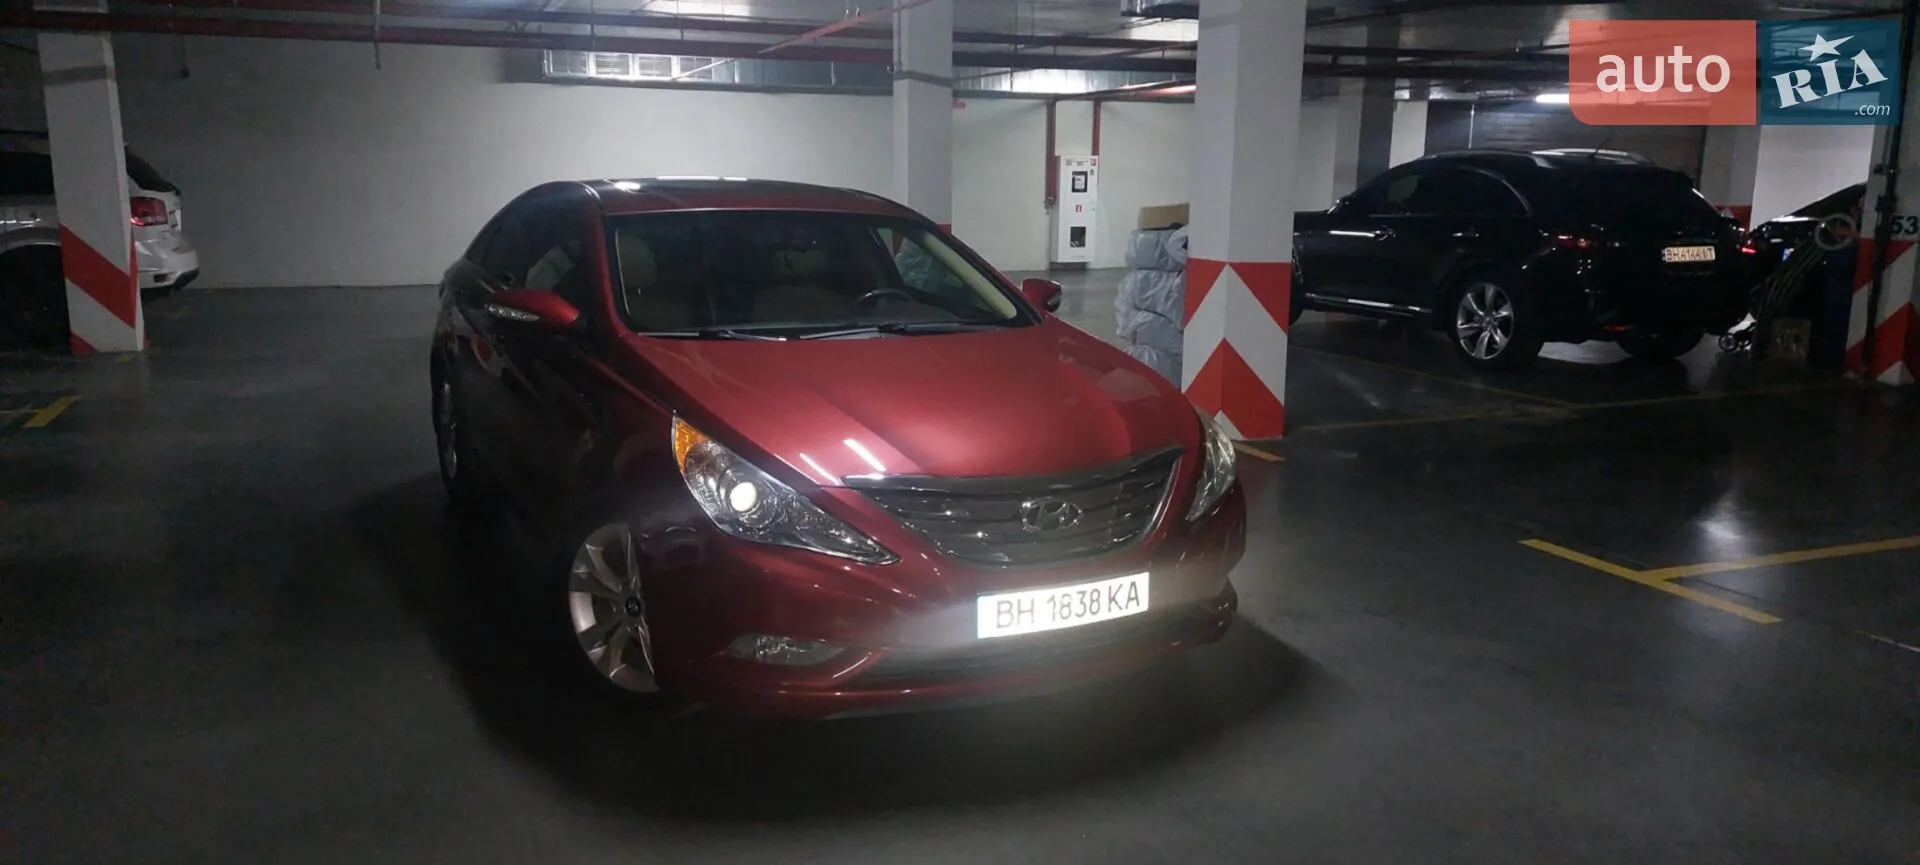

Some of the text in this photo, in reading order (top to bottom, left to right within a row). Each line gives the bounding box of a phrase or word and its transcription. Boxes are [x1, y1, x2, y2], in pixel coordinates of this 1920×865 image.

[996, 581, 1140, 629] BH 1838 KA
